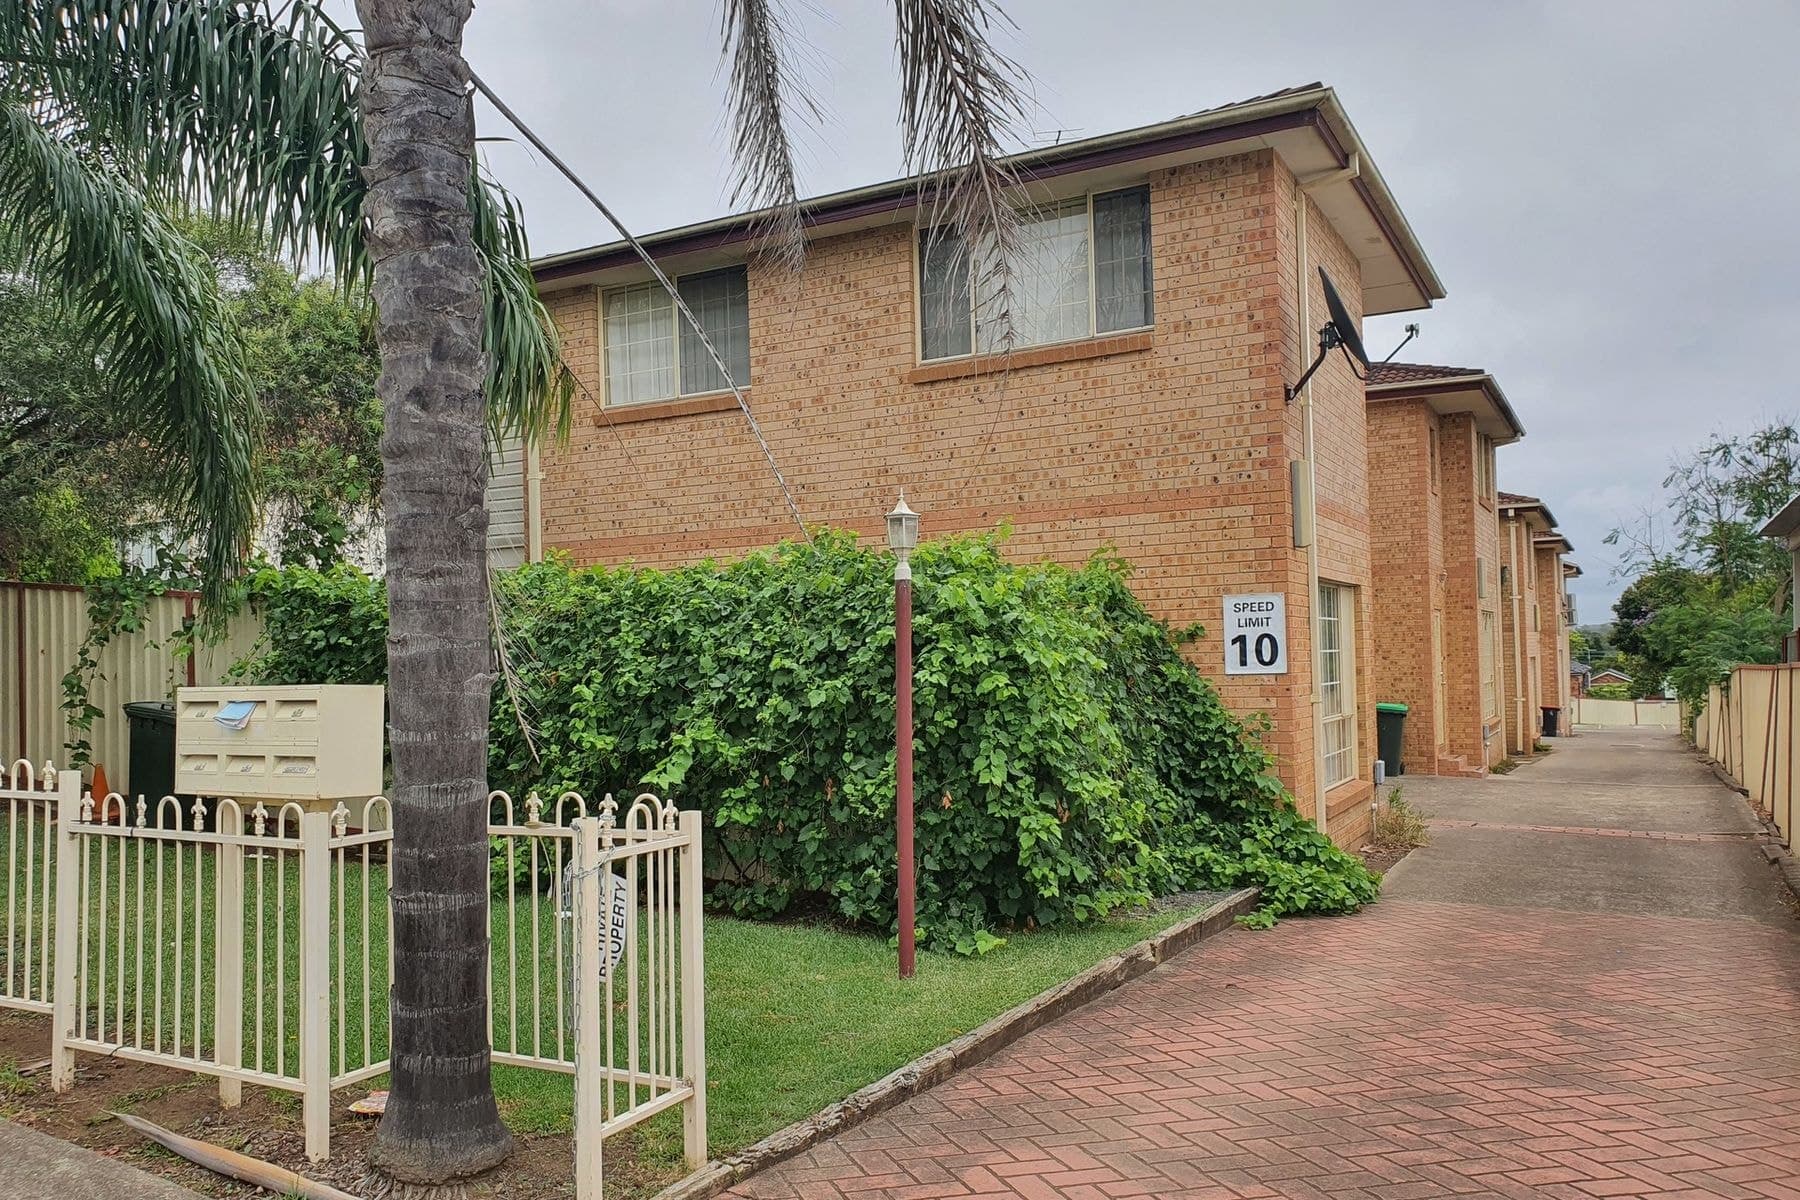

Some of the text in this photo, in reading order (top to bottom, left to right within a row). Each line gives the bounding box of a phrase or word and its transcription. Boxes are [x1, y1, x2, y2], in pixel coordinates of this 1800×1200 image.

[1233, 601, 1275, 613] SPEED
[1238, 617, 1272, 628] LIMIT
[1231, 633, 1279, 667] 10
